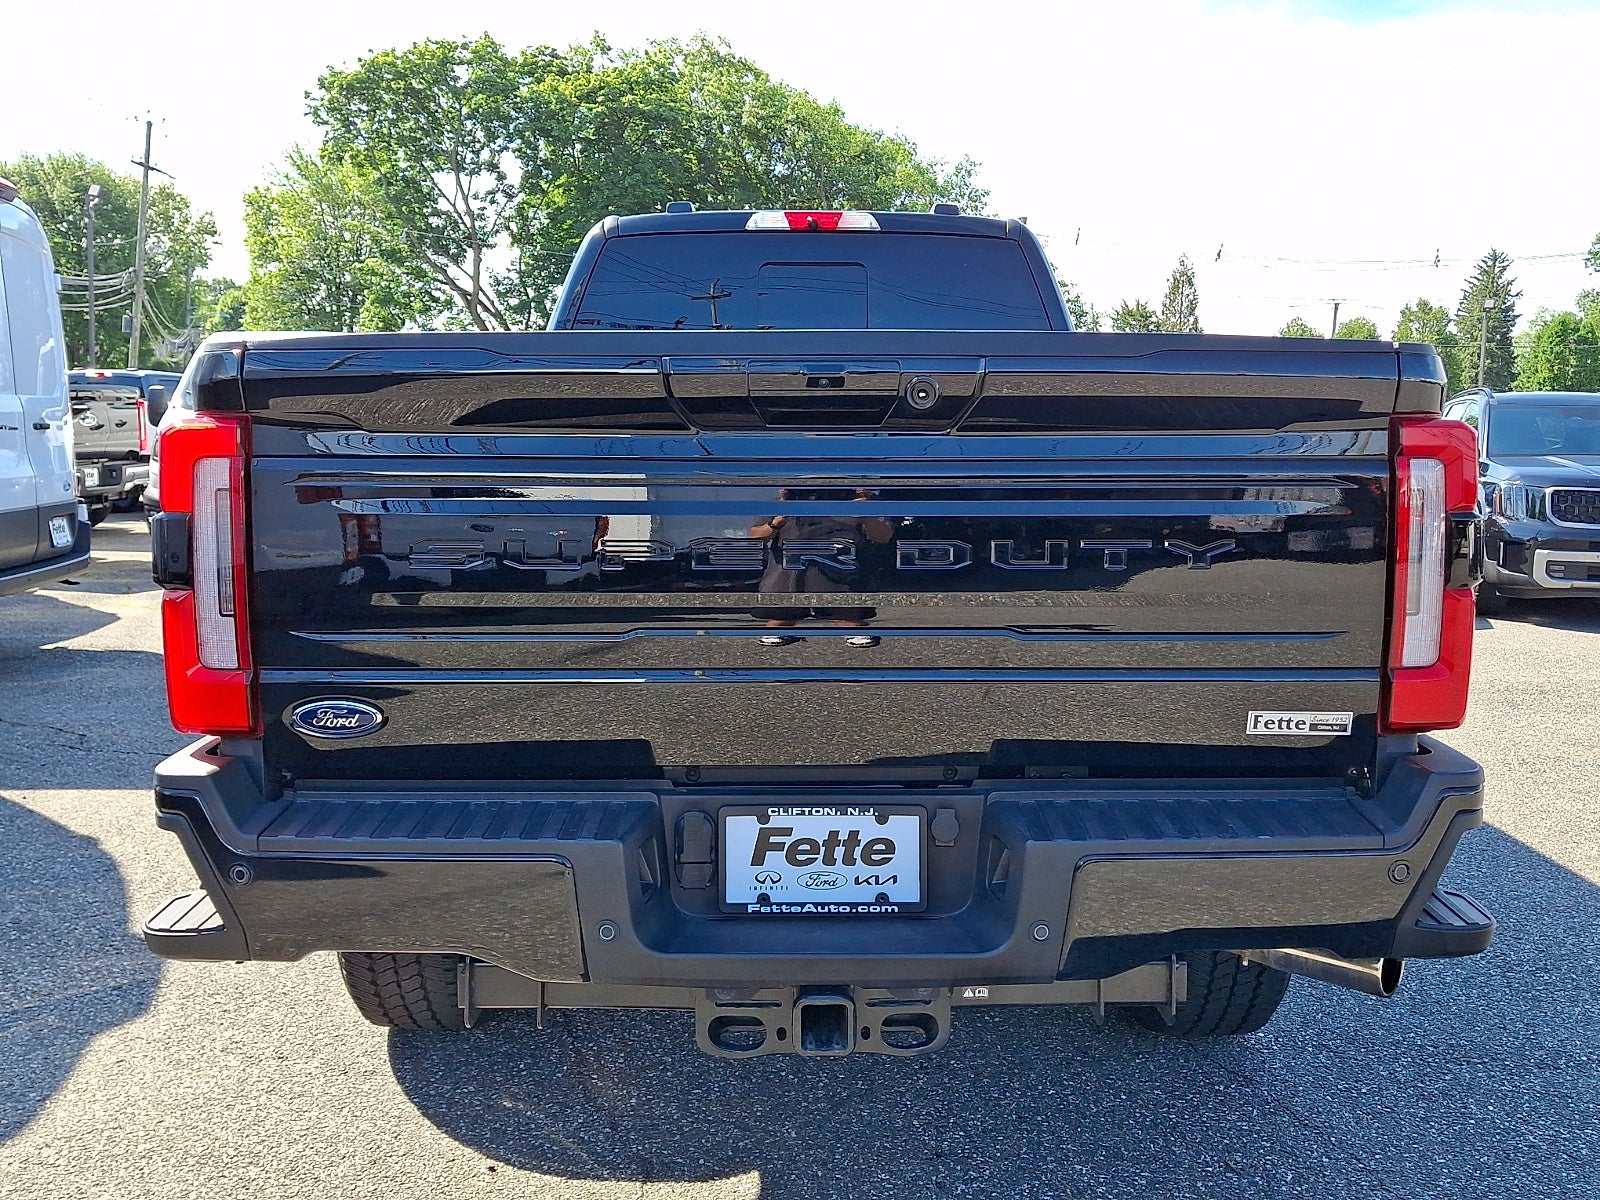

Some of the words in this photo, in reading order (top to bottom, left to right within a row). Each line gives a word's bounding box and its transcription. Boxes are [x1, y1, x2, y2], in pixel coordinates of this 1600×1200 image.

[409, 538, 856, 570] SUPER
[896, 539, 1236, 571] DUTY
[312, 708, 360, 728] Ford
[1253, 715, 1307, 730] Fette
[1311, 715, 1330, 723] Since
[767, 807, 841, 816] CLIFTON,
[847, 807, 879, 816] N.J.
[750, 827, 896, 867] Fette
[805, 873, 839, 887] Ford
[747, 903, 899, 913] FetteAuto.com
